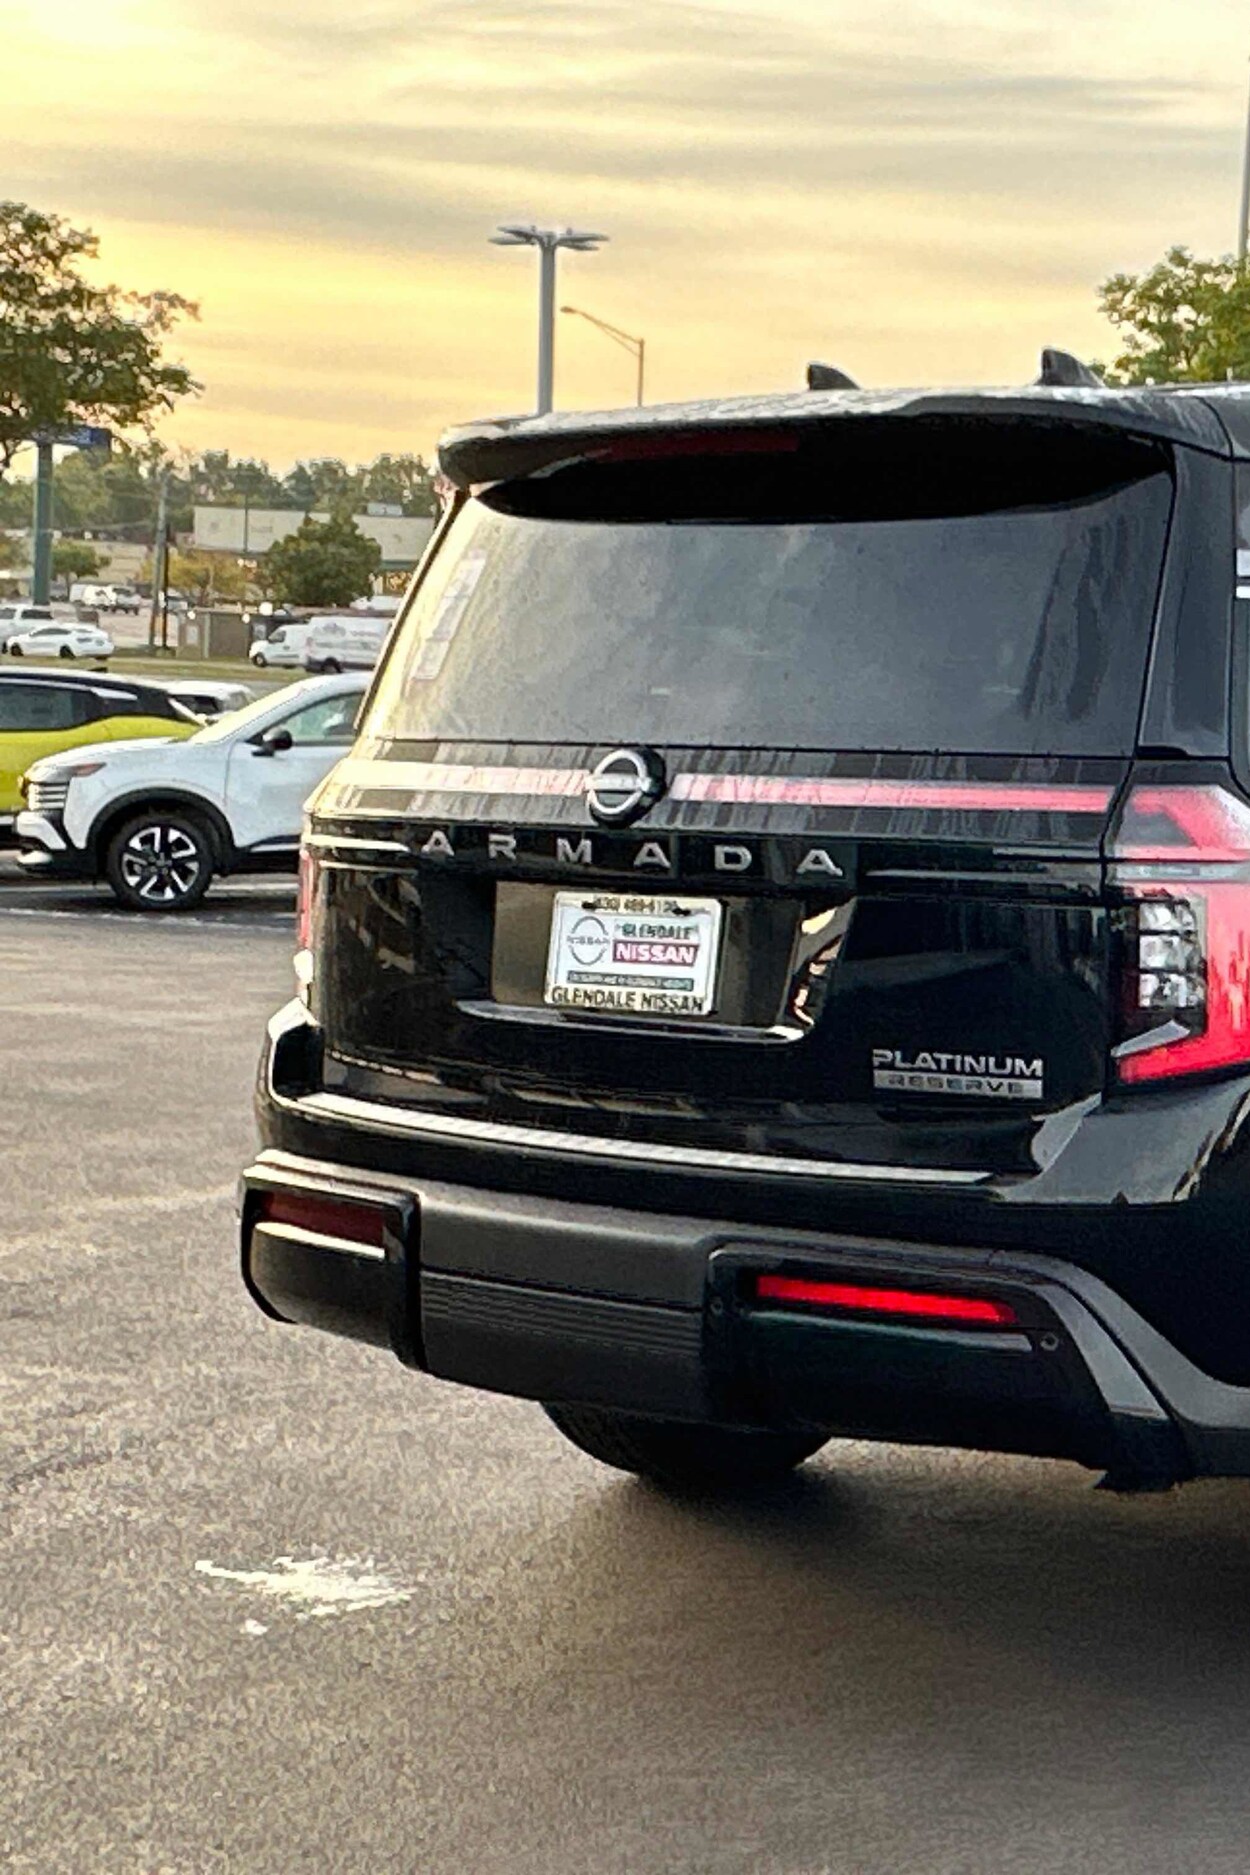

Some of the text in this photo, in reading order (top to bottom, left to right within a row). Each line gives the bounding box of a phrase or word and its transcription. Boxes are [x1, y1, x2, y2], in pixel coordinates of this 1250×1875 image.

[422, 830, 843, 876] ARMADA
[615, 942, 695, 964] NISSAN
[551, 985, 636, 1009] GLENDALE
[640, 992, 704, 1012] NISSAN
[872, 1048, 1043, 1078] PLATINUM
[887, 1072, 1024, 1095] RESERVE
